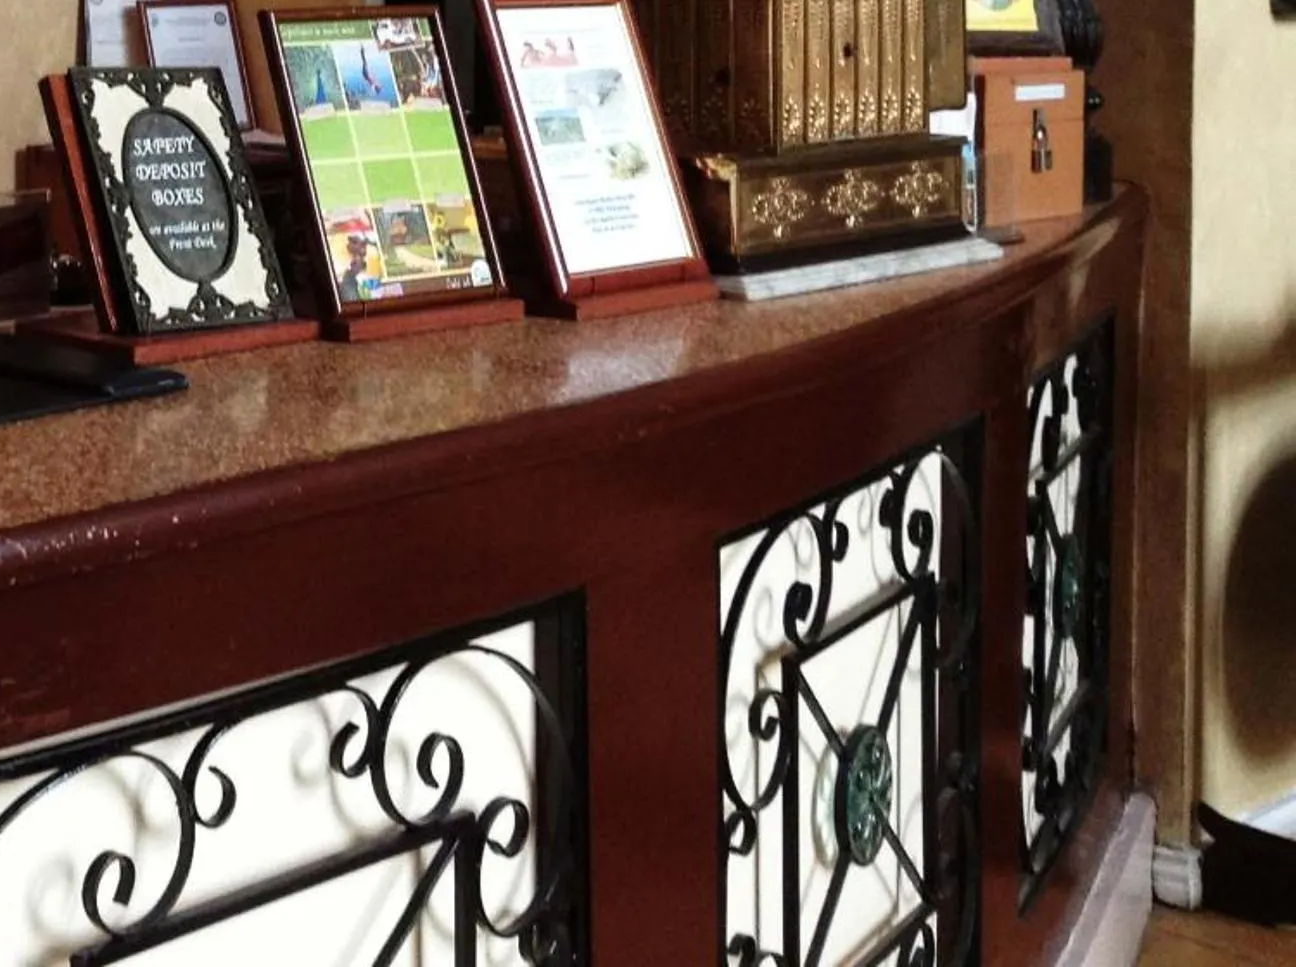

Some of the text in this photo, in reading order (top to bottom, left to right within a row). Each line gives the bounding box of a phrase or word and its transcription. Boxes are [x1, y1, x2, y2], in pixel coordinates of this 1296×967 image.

[132, 134, 197, 156] SAFETY
[135, 159, 206, 181] DEPOSIT
[151, 186, 205, 207] BOXES
